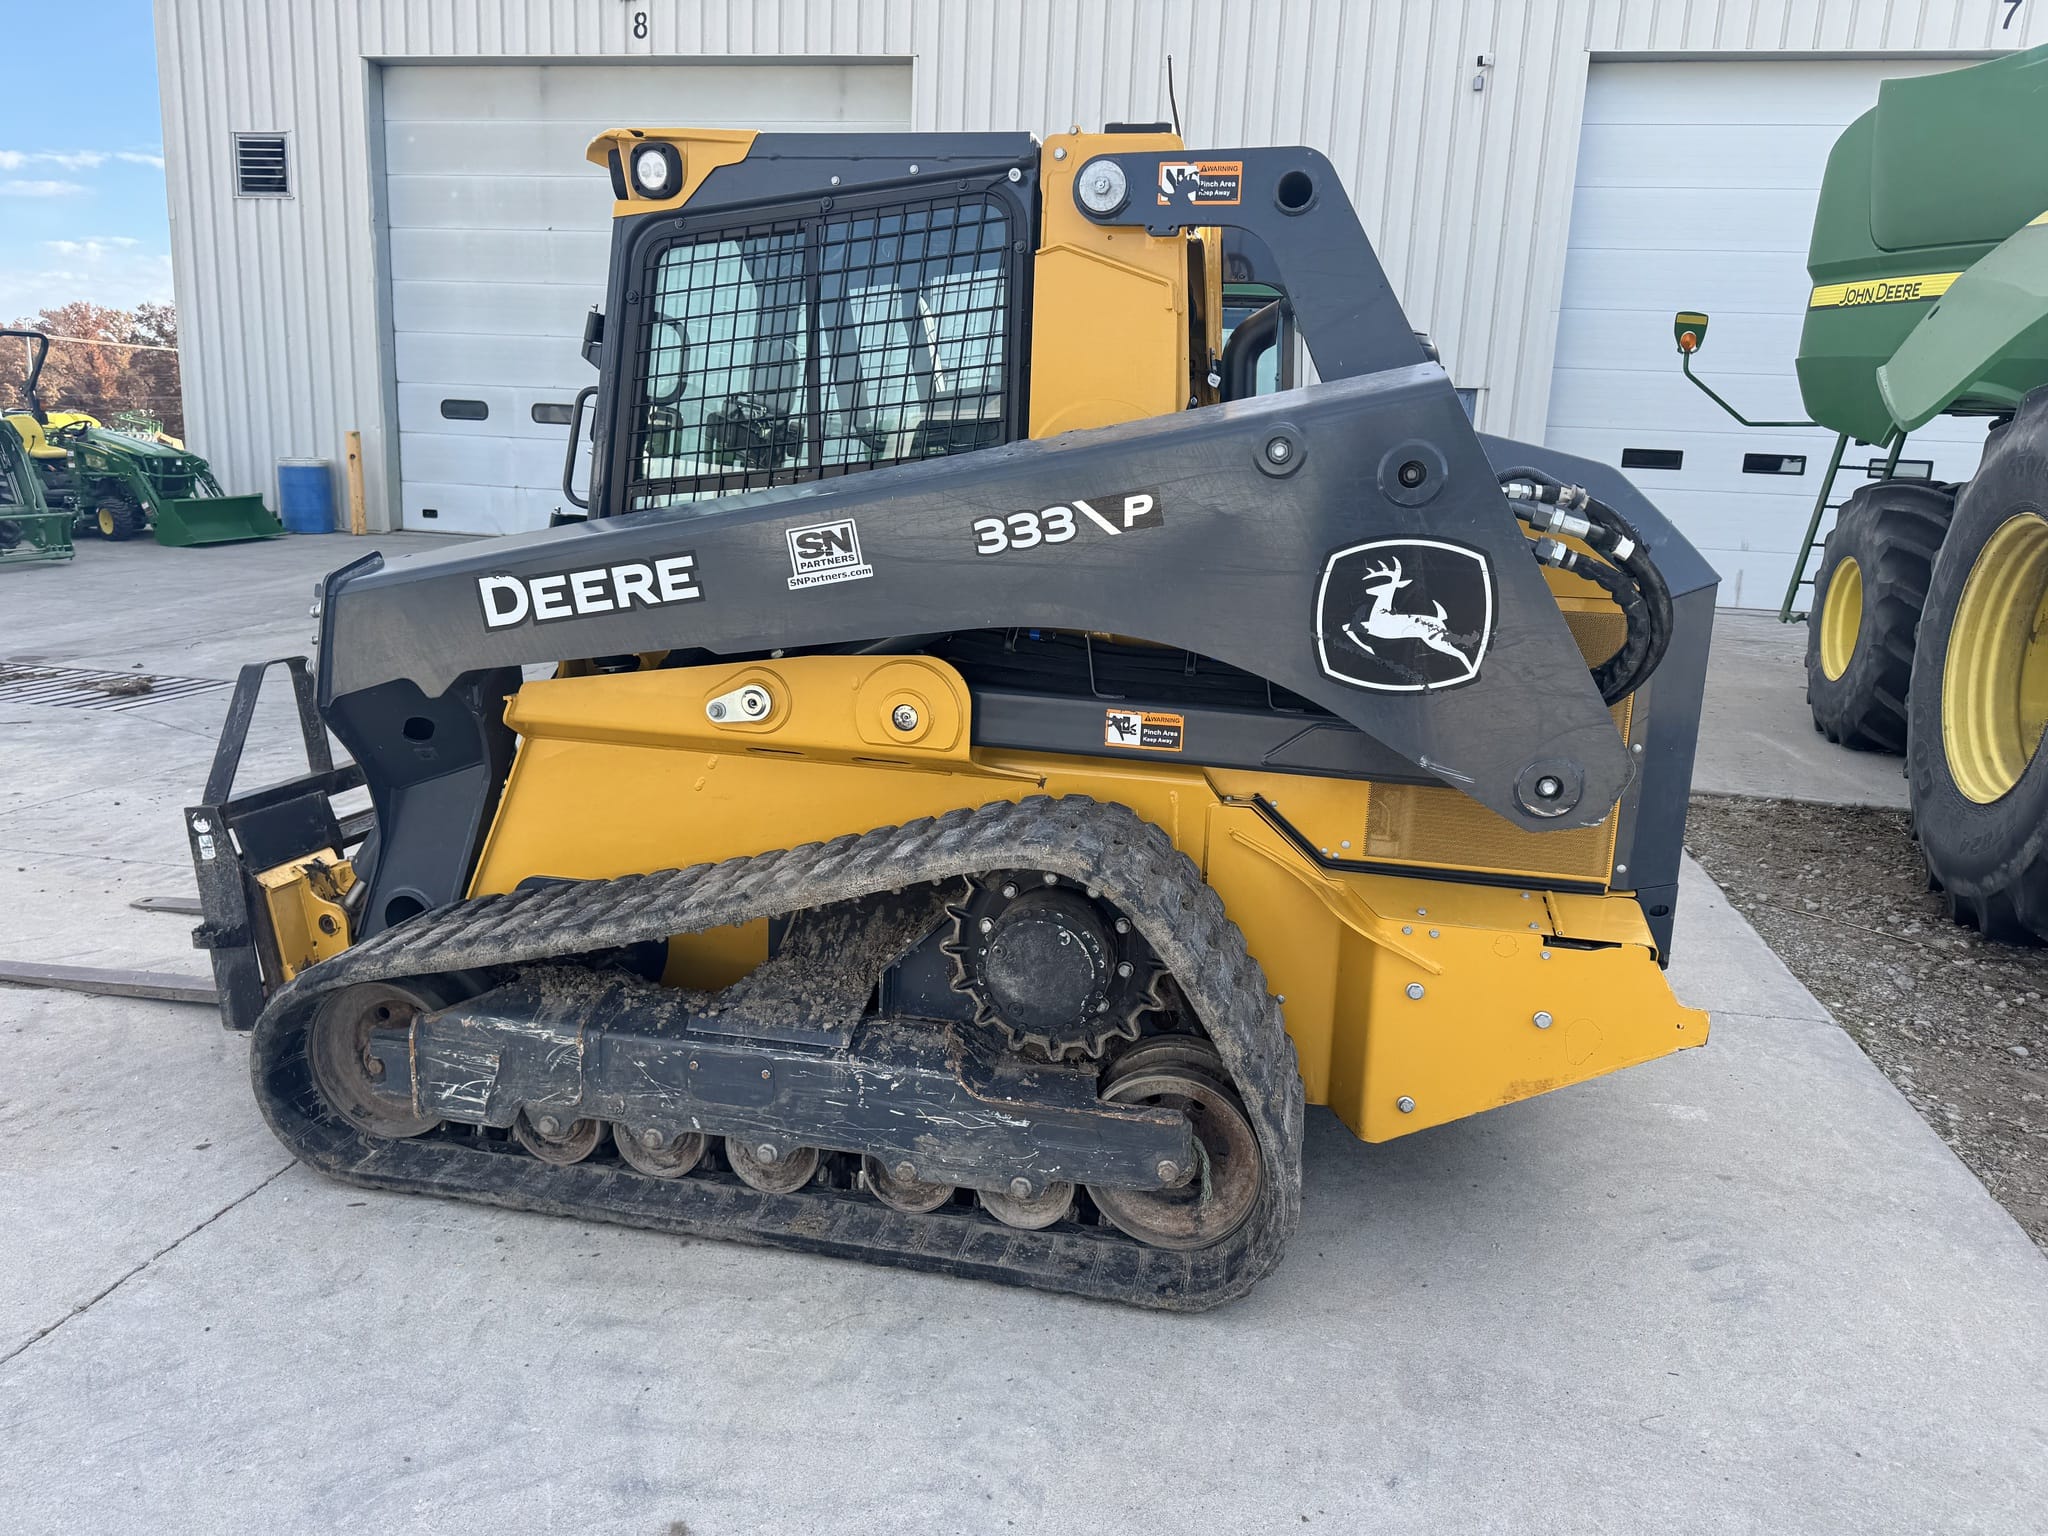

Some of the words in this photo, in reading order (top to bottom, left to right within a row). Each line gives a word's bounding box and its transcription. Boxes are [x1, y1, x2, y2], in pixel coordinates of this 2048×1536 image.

[633, 11, 648, 39] 8
[2002, 0, 2022, 30] 7
[1214, 189, 1231, 197] Away
[1219, 180, 1236, 188] Area
[1839, 287, 1875, 305] JOHN
[1876, 282, 1923, 301] DEERE
[796, 526, 854, 560] SN
[800, 554, 855, 570] PARTNERS
[789, 567, 872, 588] SNPartners.com
[478, 555, 700, 628] DEERE
[1150, 716, 1181, 724] WARNING
[1143, 728, 1162, 736] Pinch
[1162, 729, 1178, 737] Area
